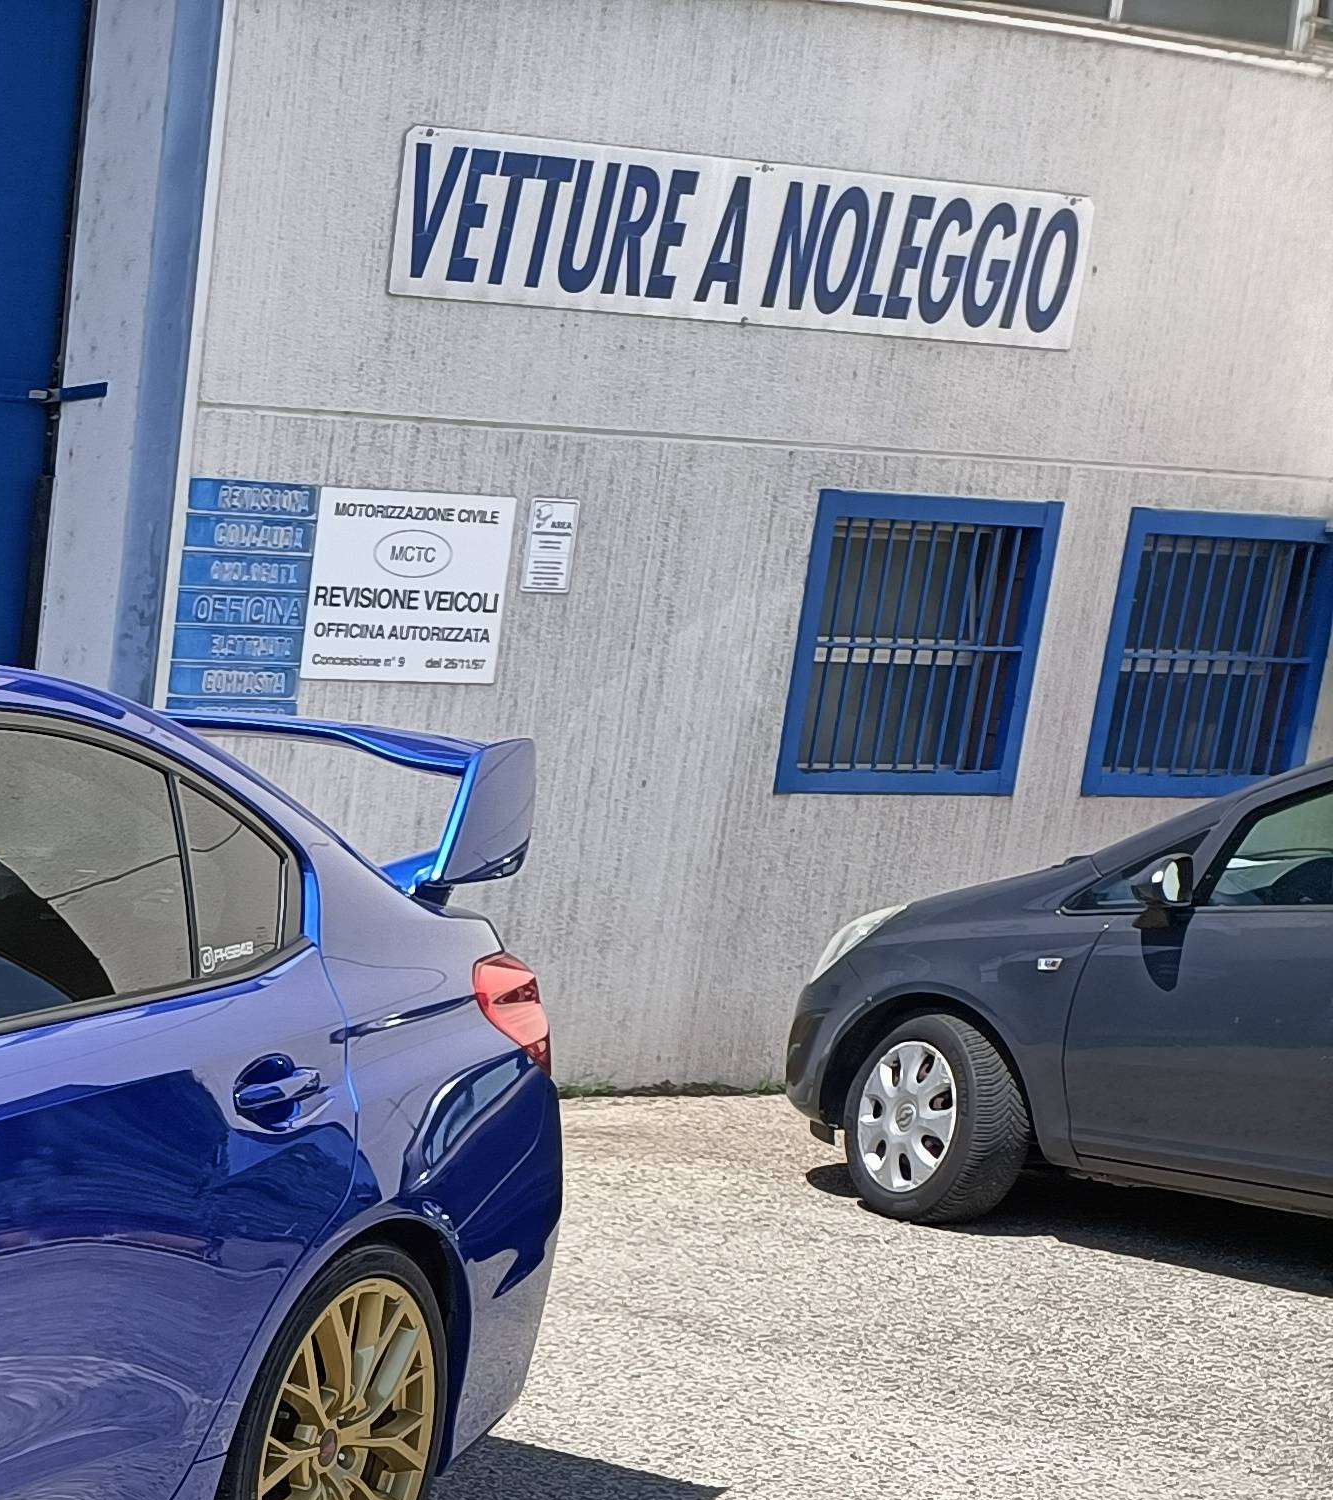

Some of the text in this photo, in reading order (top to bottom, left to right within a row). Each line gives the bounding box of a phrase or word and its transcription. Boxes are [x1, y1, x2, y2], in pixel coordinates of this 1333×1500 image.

[410, 142, 1080, 333] VETTURE A NOLEGGIO
[334, 502, 499, 524] MOTORIZZAZIONE CIVILE
[389, 545, 437, 563] MCTC
[192, 594, 302, 625] OFFICINA
[313, 586, 499, 613] REVISIONE VEICOLI
[313, 622, 490, 643] OFFICINA AUTORIZZATA
[312, 653, 382, 667] Concessione
